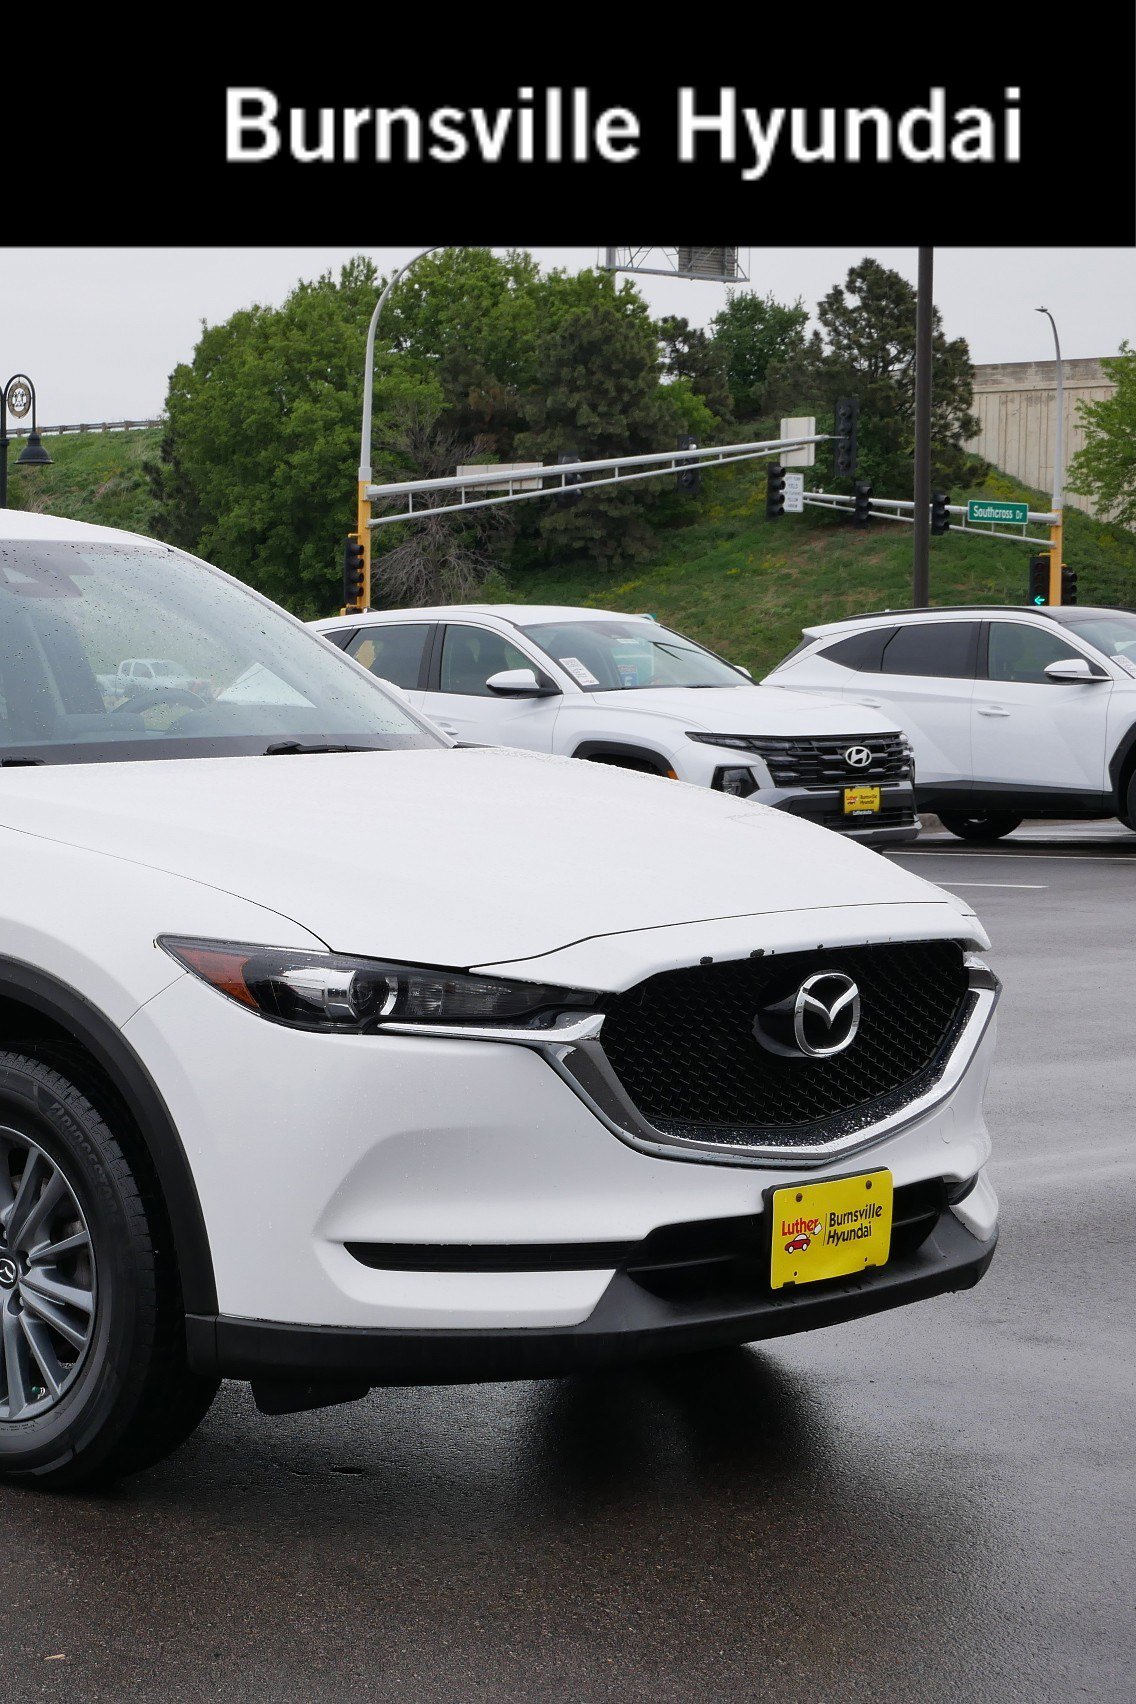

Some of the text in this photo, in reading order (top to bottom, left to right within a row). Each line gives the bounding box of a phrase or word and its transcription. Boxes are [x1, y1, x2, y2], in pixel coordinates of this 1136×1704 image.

[973, 505, 1024, 520] Southcross Dr
[782, 1217, 819, 1236] Luther
[829, 1203, 883, 1228] Burnsville
[826, 1221, 872, 1246] Hyundai
